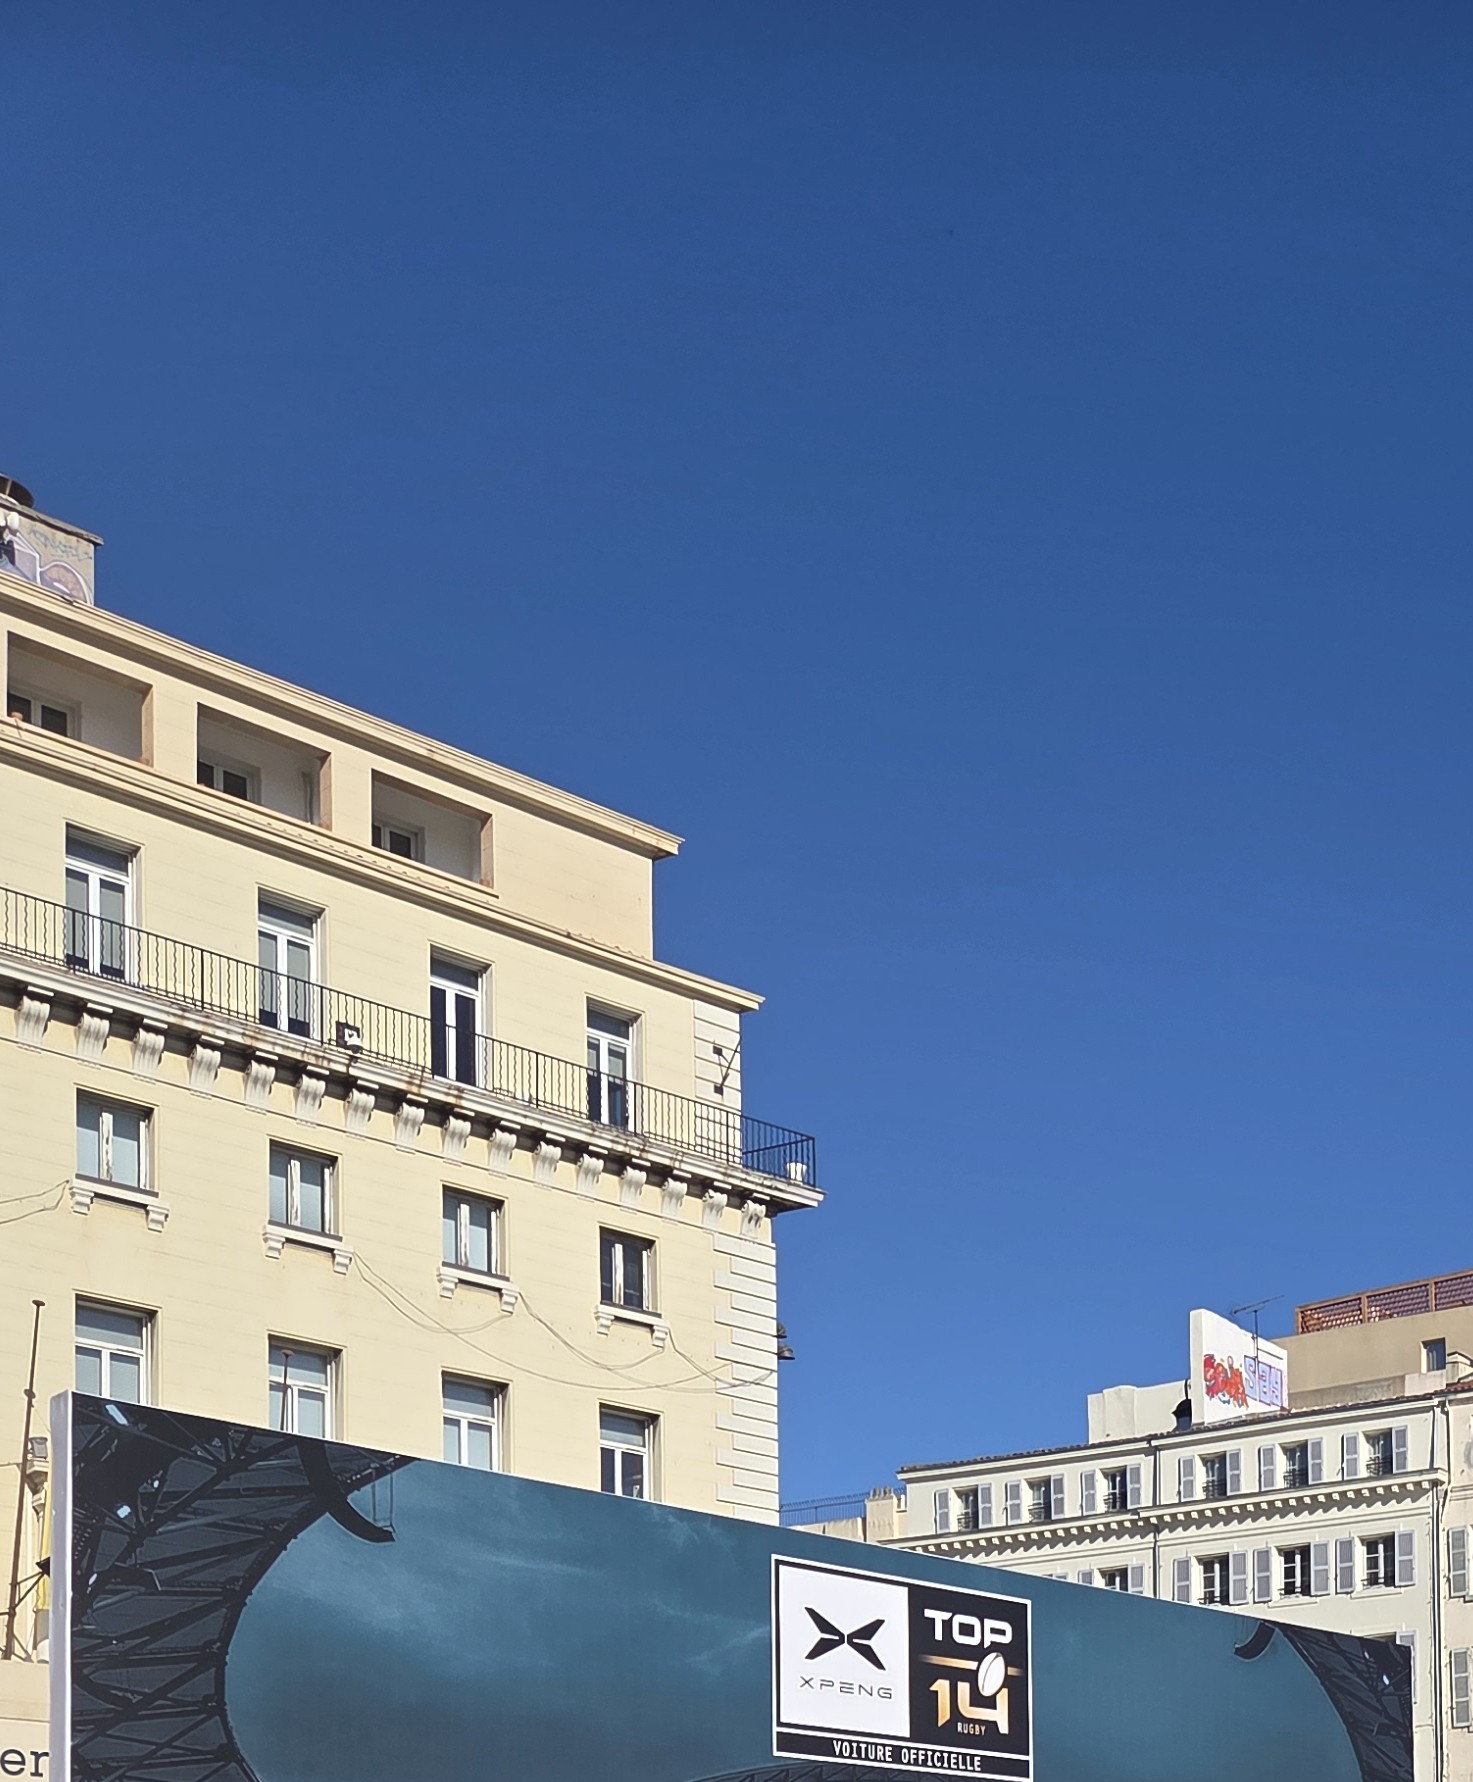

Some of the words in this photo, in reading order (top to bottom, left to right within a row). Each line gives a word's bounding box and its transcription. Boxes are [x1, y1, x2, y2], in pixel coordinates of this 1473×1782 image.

[924, 1608, 1013, 1649] TOP
[799, 1675, 892, 1700] XPENG
[929, 1679, 1009, 1735] 14
[957, 1721, 986, 1737] RUGBY
[832, 1740, 893, 1762] VOITURE
[901, 1750, 982, 1772] OFFICIELLE
